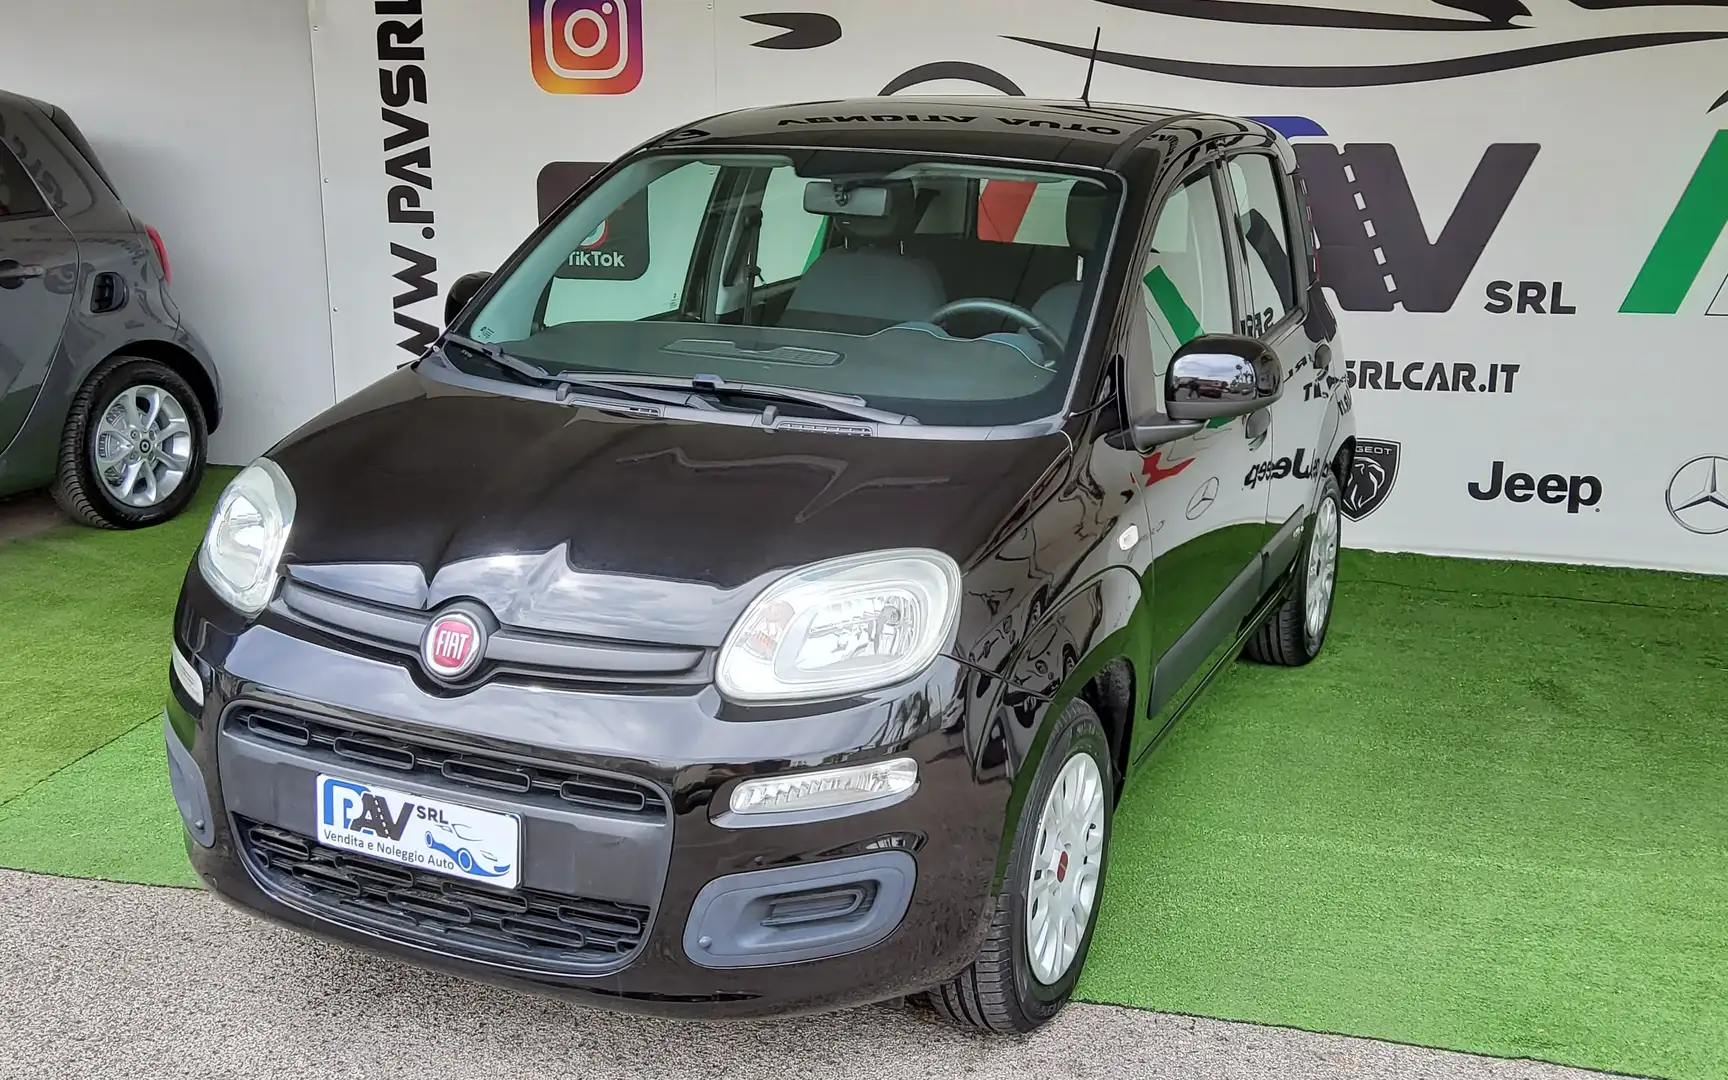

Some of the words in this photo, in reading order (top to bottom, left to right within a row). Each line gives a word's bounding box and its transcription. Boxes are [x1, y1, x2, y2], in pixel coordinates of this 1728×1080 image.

[568, 251, 626, 268] TikTok
[1484, 281, 1577, 314] SRL
[1468, 461, 1602, 513] Jeep
[435, 629, 470, 660] FIAT
[416, 805, 449, 825] SRL
[323, 828, 365, 848] Vendita
[367, 841, 374, 851] e
[376, 842, 425, 863] Noleggio
[427, 854, 455, 871] Auto
